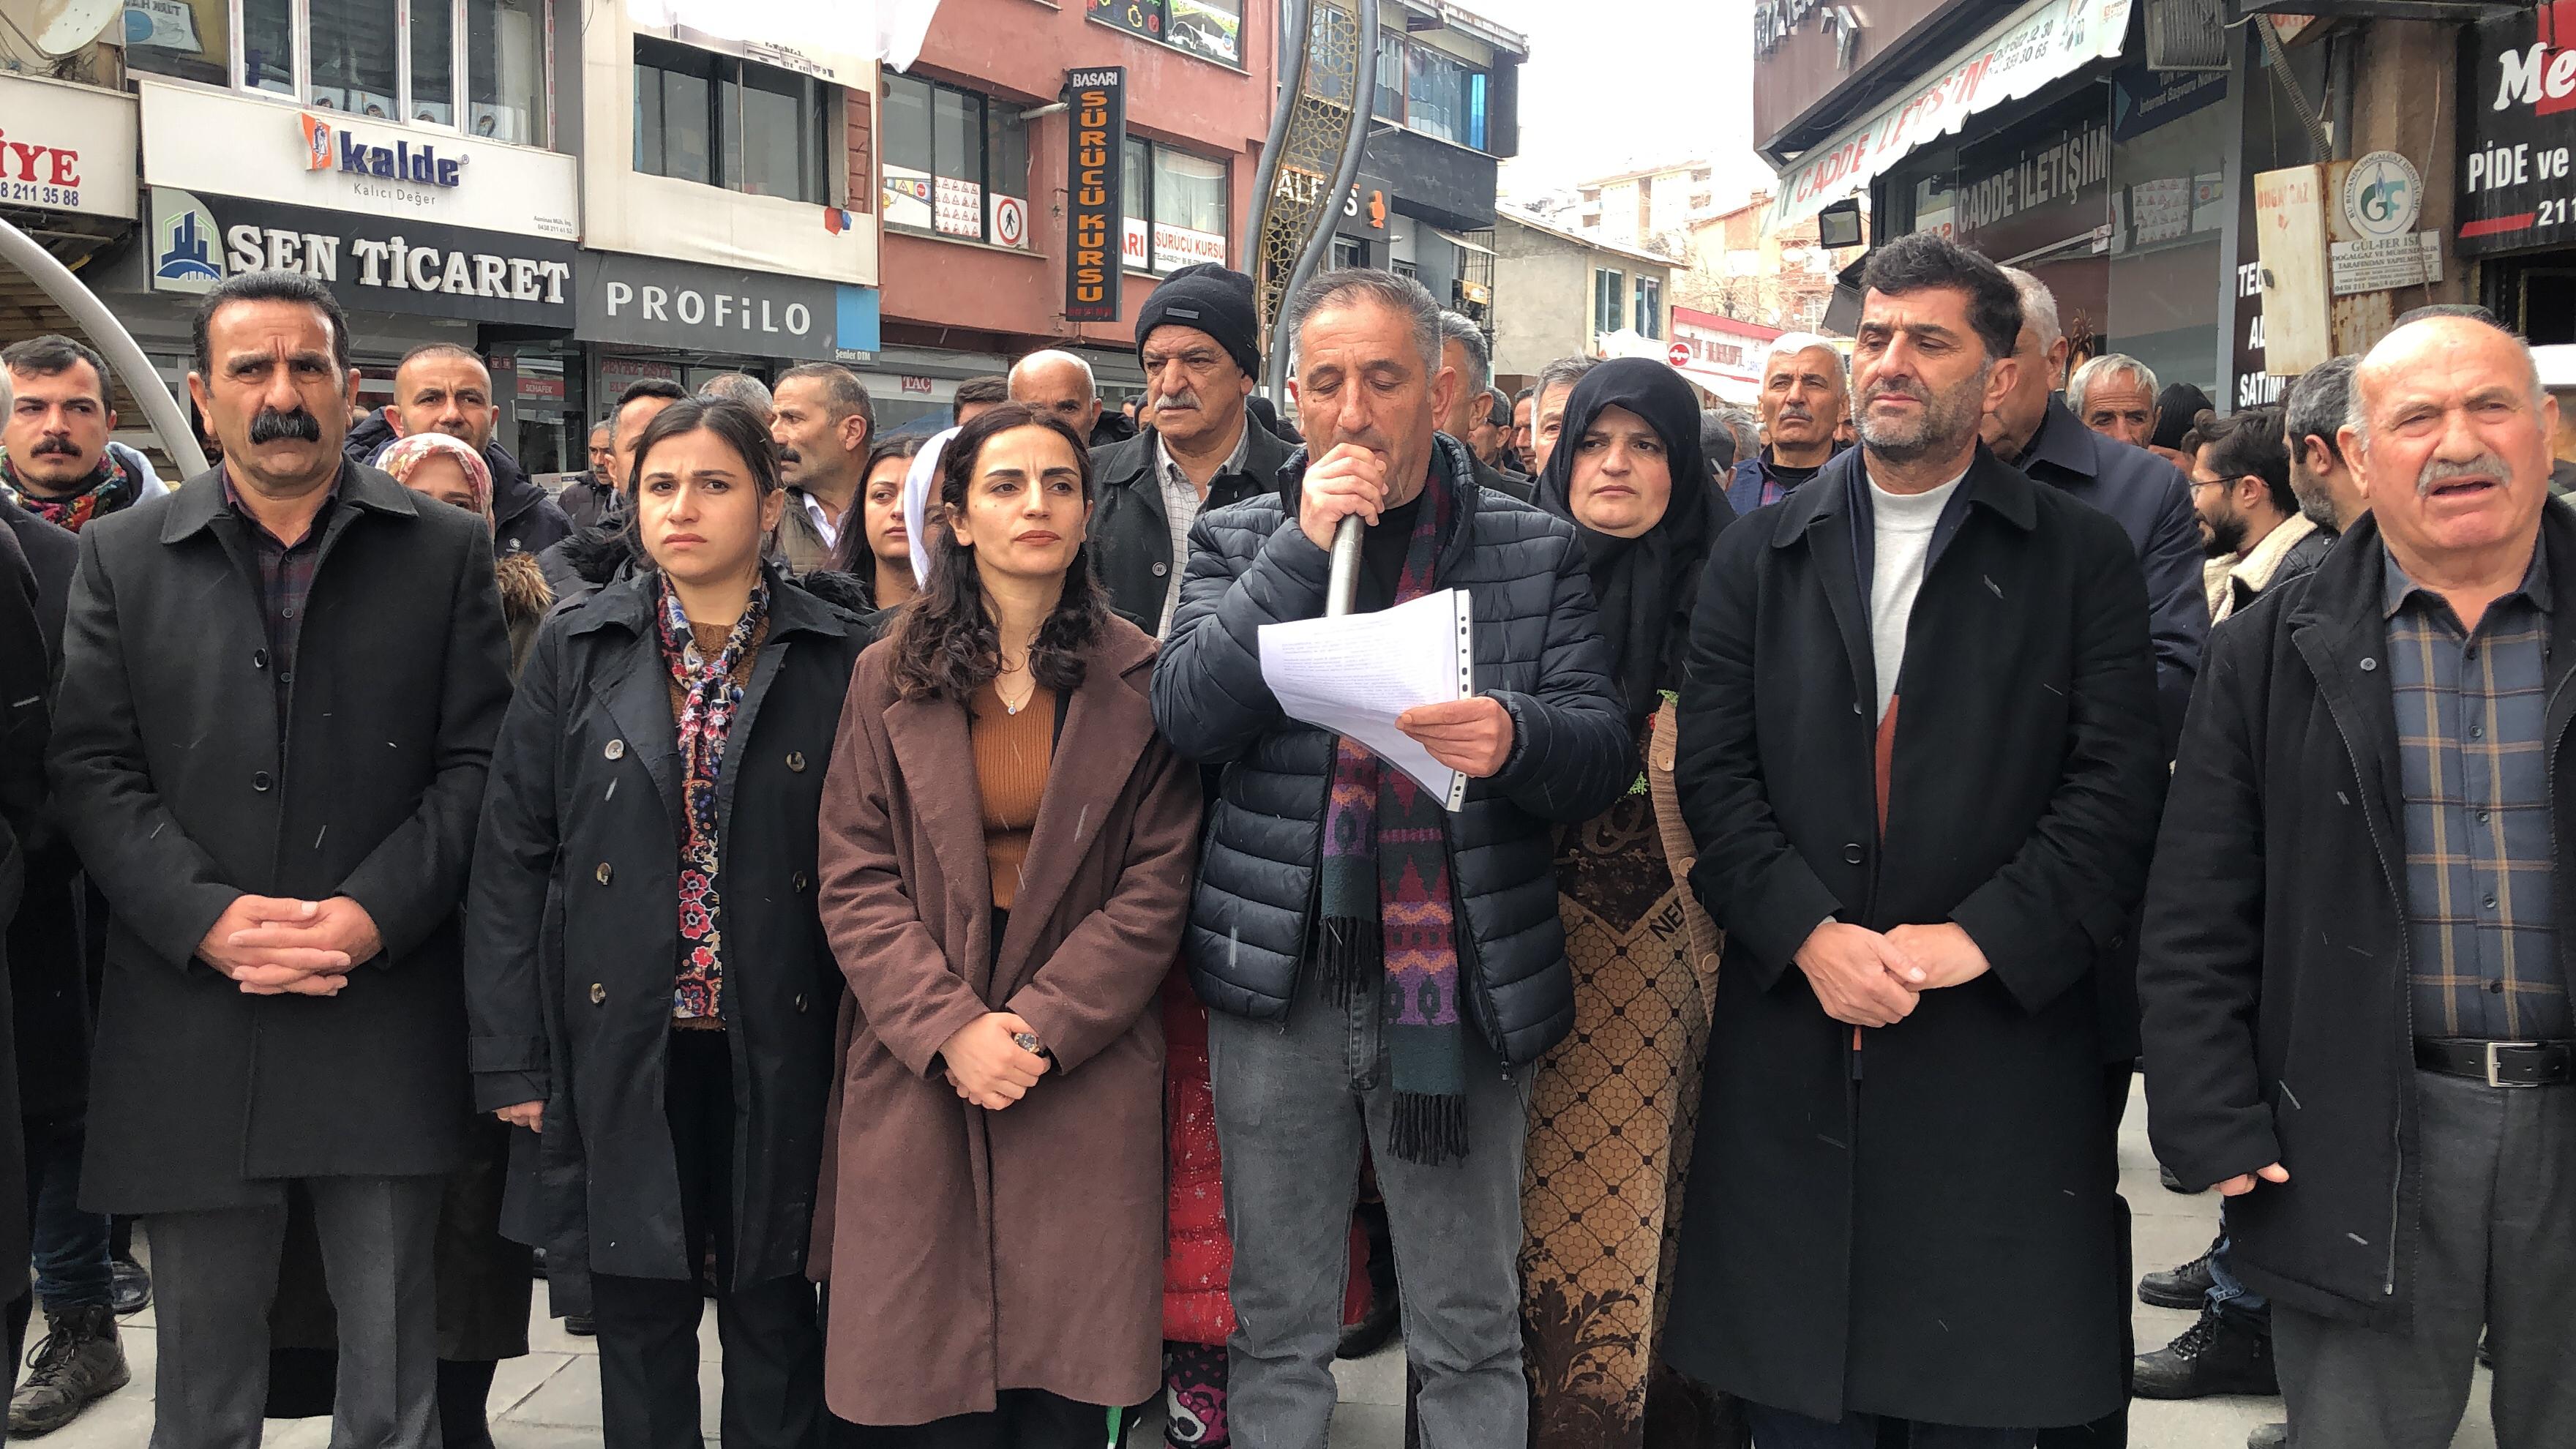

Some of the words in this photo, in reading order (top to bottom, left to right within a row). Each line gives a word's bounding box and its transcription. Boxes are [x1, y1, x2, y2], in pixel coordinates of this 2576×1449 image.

[339, 130, 460, 188] kalde
[1079, 91, 1108, 206] SÜRÜCÜ
[1959, 167, 2014, 233] CADDE
[2019, 119, 2108, 211] İLETİŞİM
[2468, 141, 2528, 193] PİDE
[2536, 147, 2569, 181] ve
[13, 183, 37, 202] 211
[42, 187, 59, 204] 35
[63, 189, 79, 207] 88
[354, 183, 392, 200] Kalıcı
[397, 189, 436, 206] Değer
[352, 236, 570, 304] TİCARET
[1077, 214, 1106, 302] KURSU
[1195, 239, 1224, 260] KURSU
[904, 376, 930, 392] TAÇ
